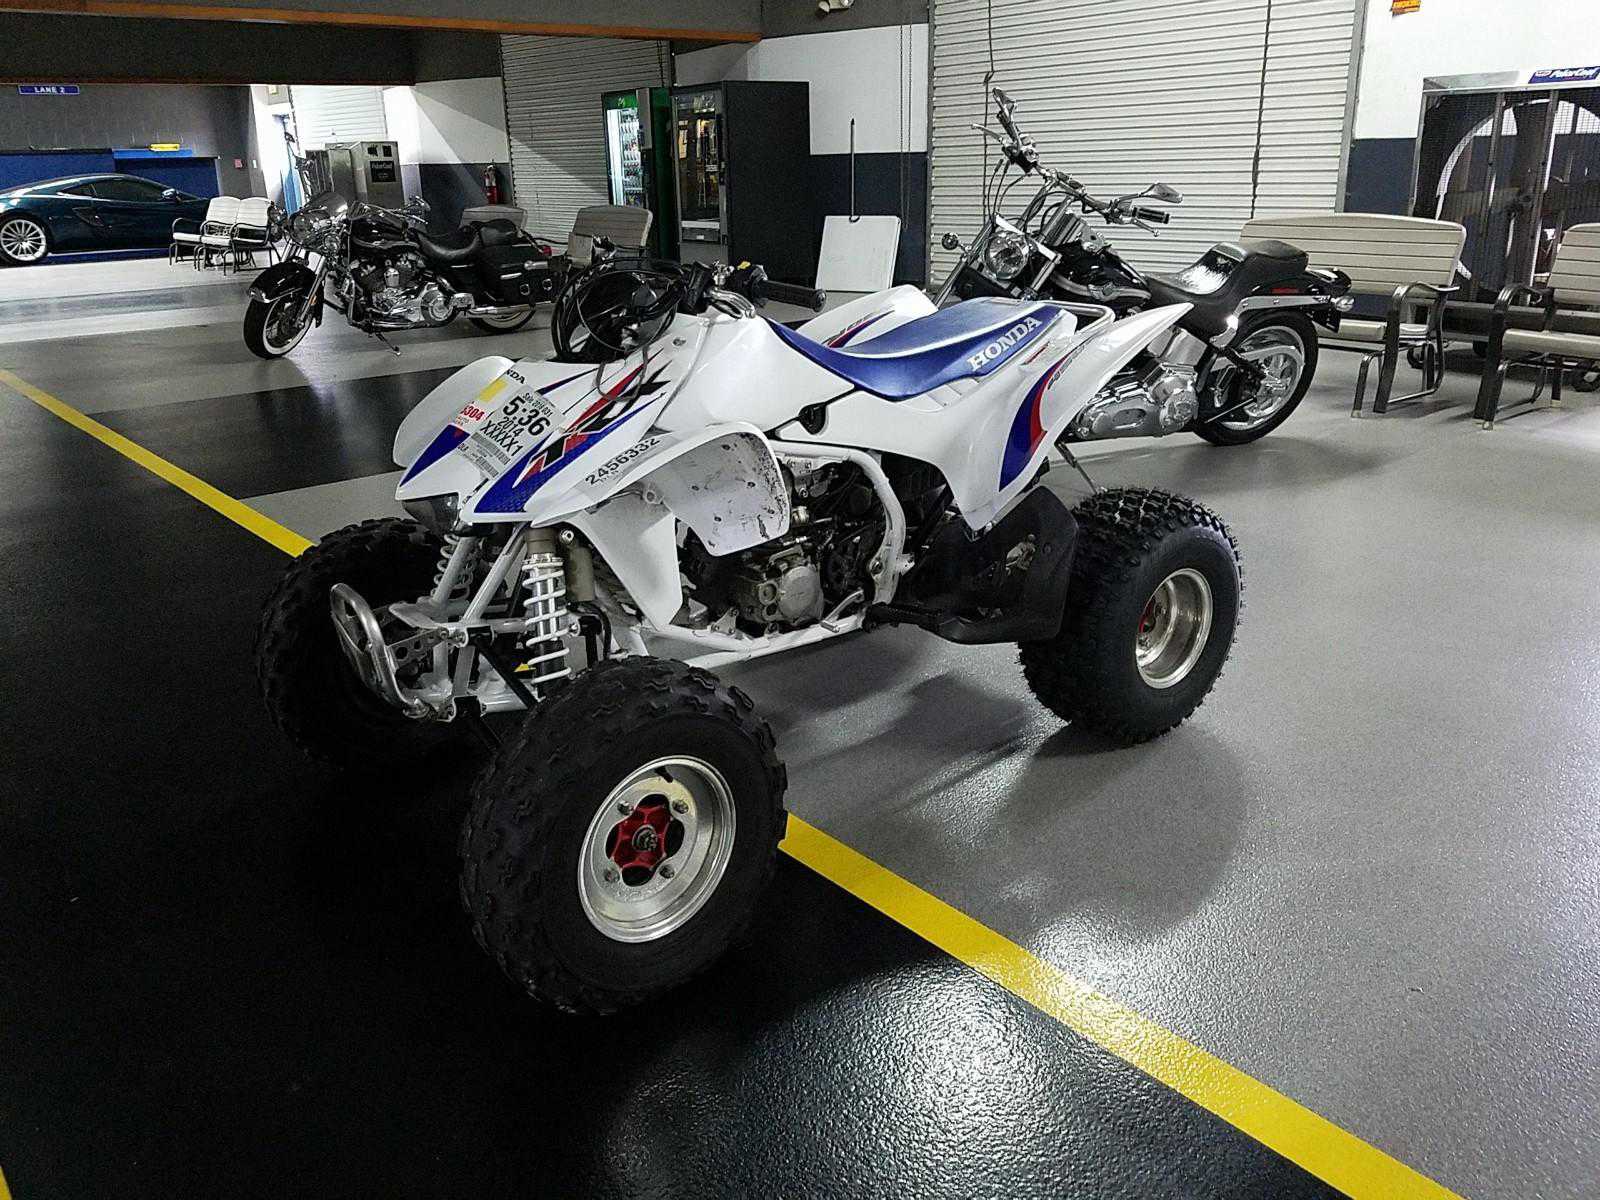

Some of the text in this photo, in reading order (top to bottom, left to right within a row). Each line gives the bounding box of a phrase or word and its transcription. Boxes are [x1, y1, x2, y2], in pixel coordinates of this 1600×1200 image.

[966, 316, 1043, 372] HONDA
[497, 416, 524, 437] 2014
[502, 395, 551, 436] 5:36
[480, 420, 523, 456] XXXXX1
[585, 438, 660, 485] 2456332
